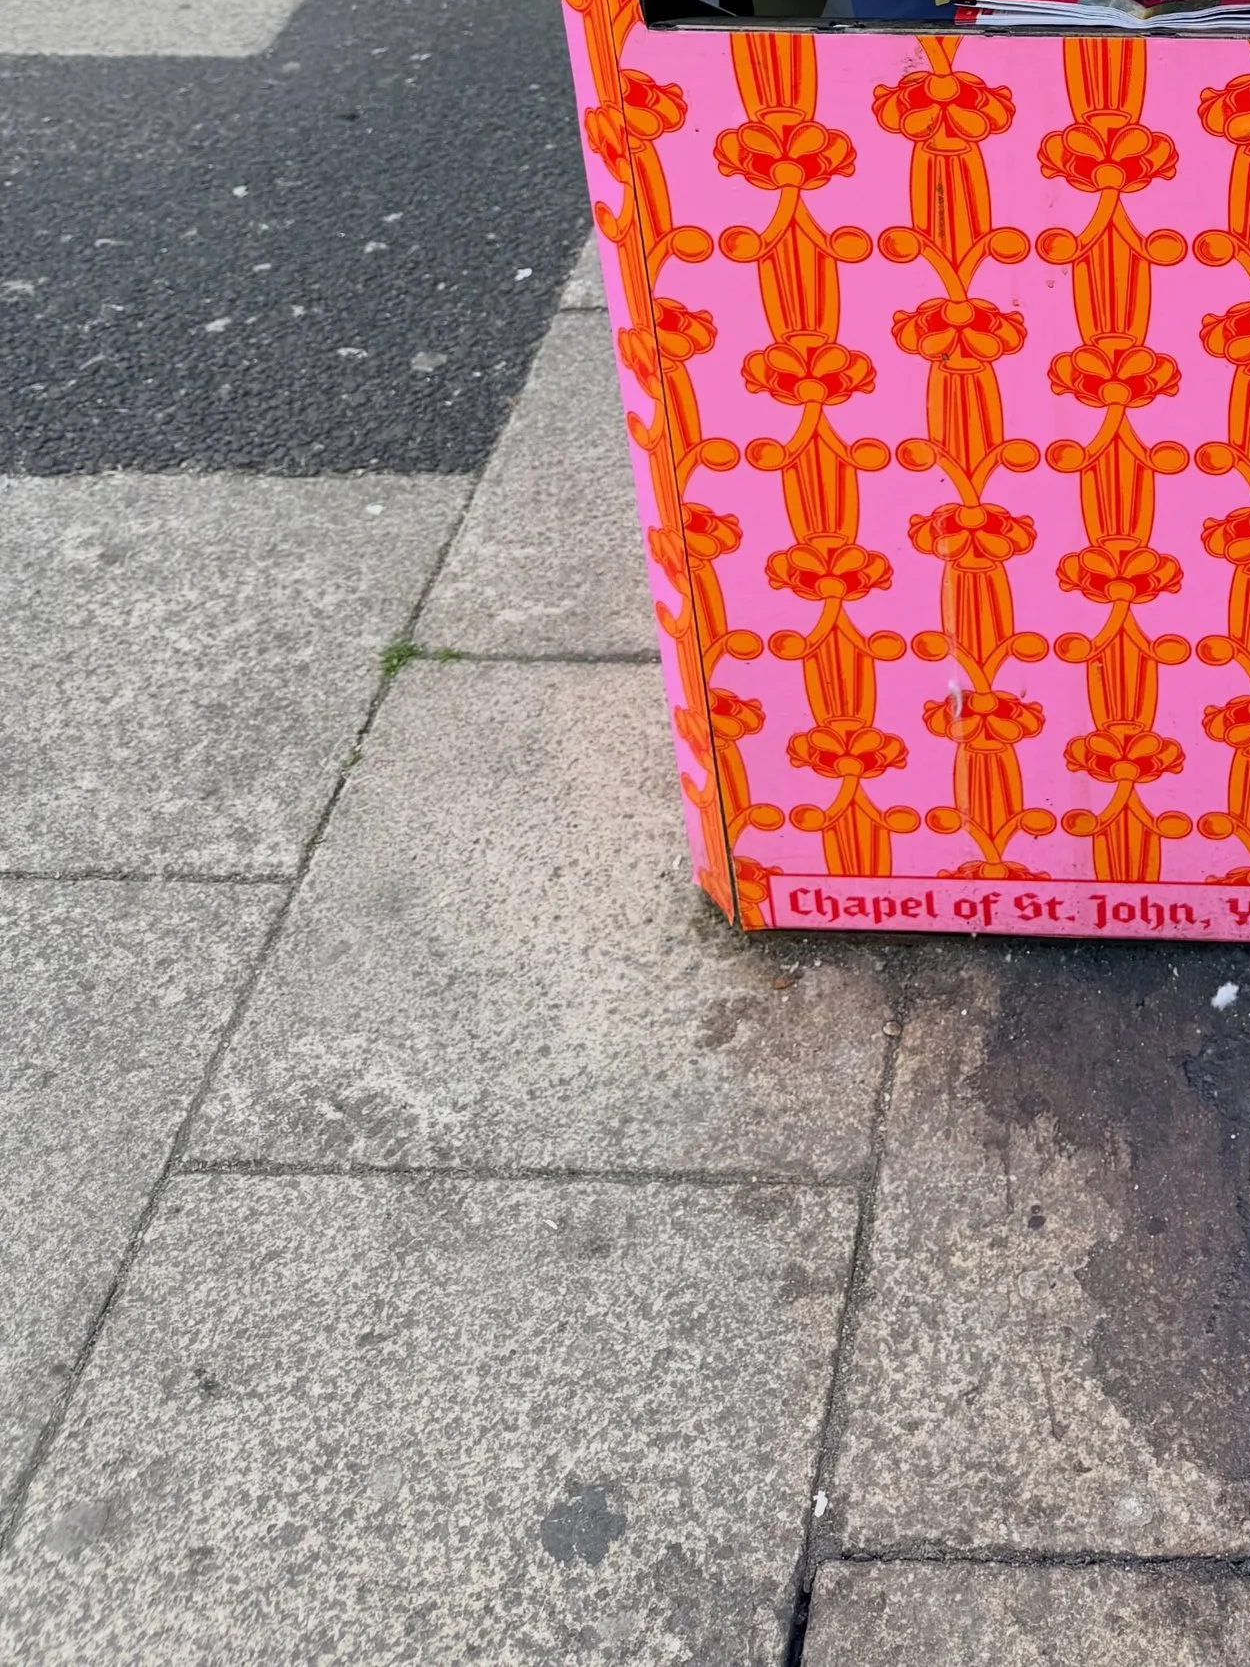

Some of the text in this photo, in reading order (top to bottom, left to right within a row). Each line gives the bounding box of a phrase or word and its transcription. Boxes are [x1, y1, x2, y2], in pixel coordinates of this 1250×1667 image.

[789, 886, 939, 925] Chapel
[953, 891, 1003, 928] of
[1013, 892, 1077, 923] St.
[1088, 894, 1212, 931] John,
